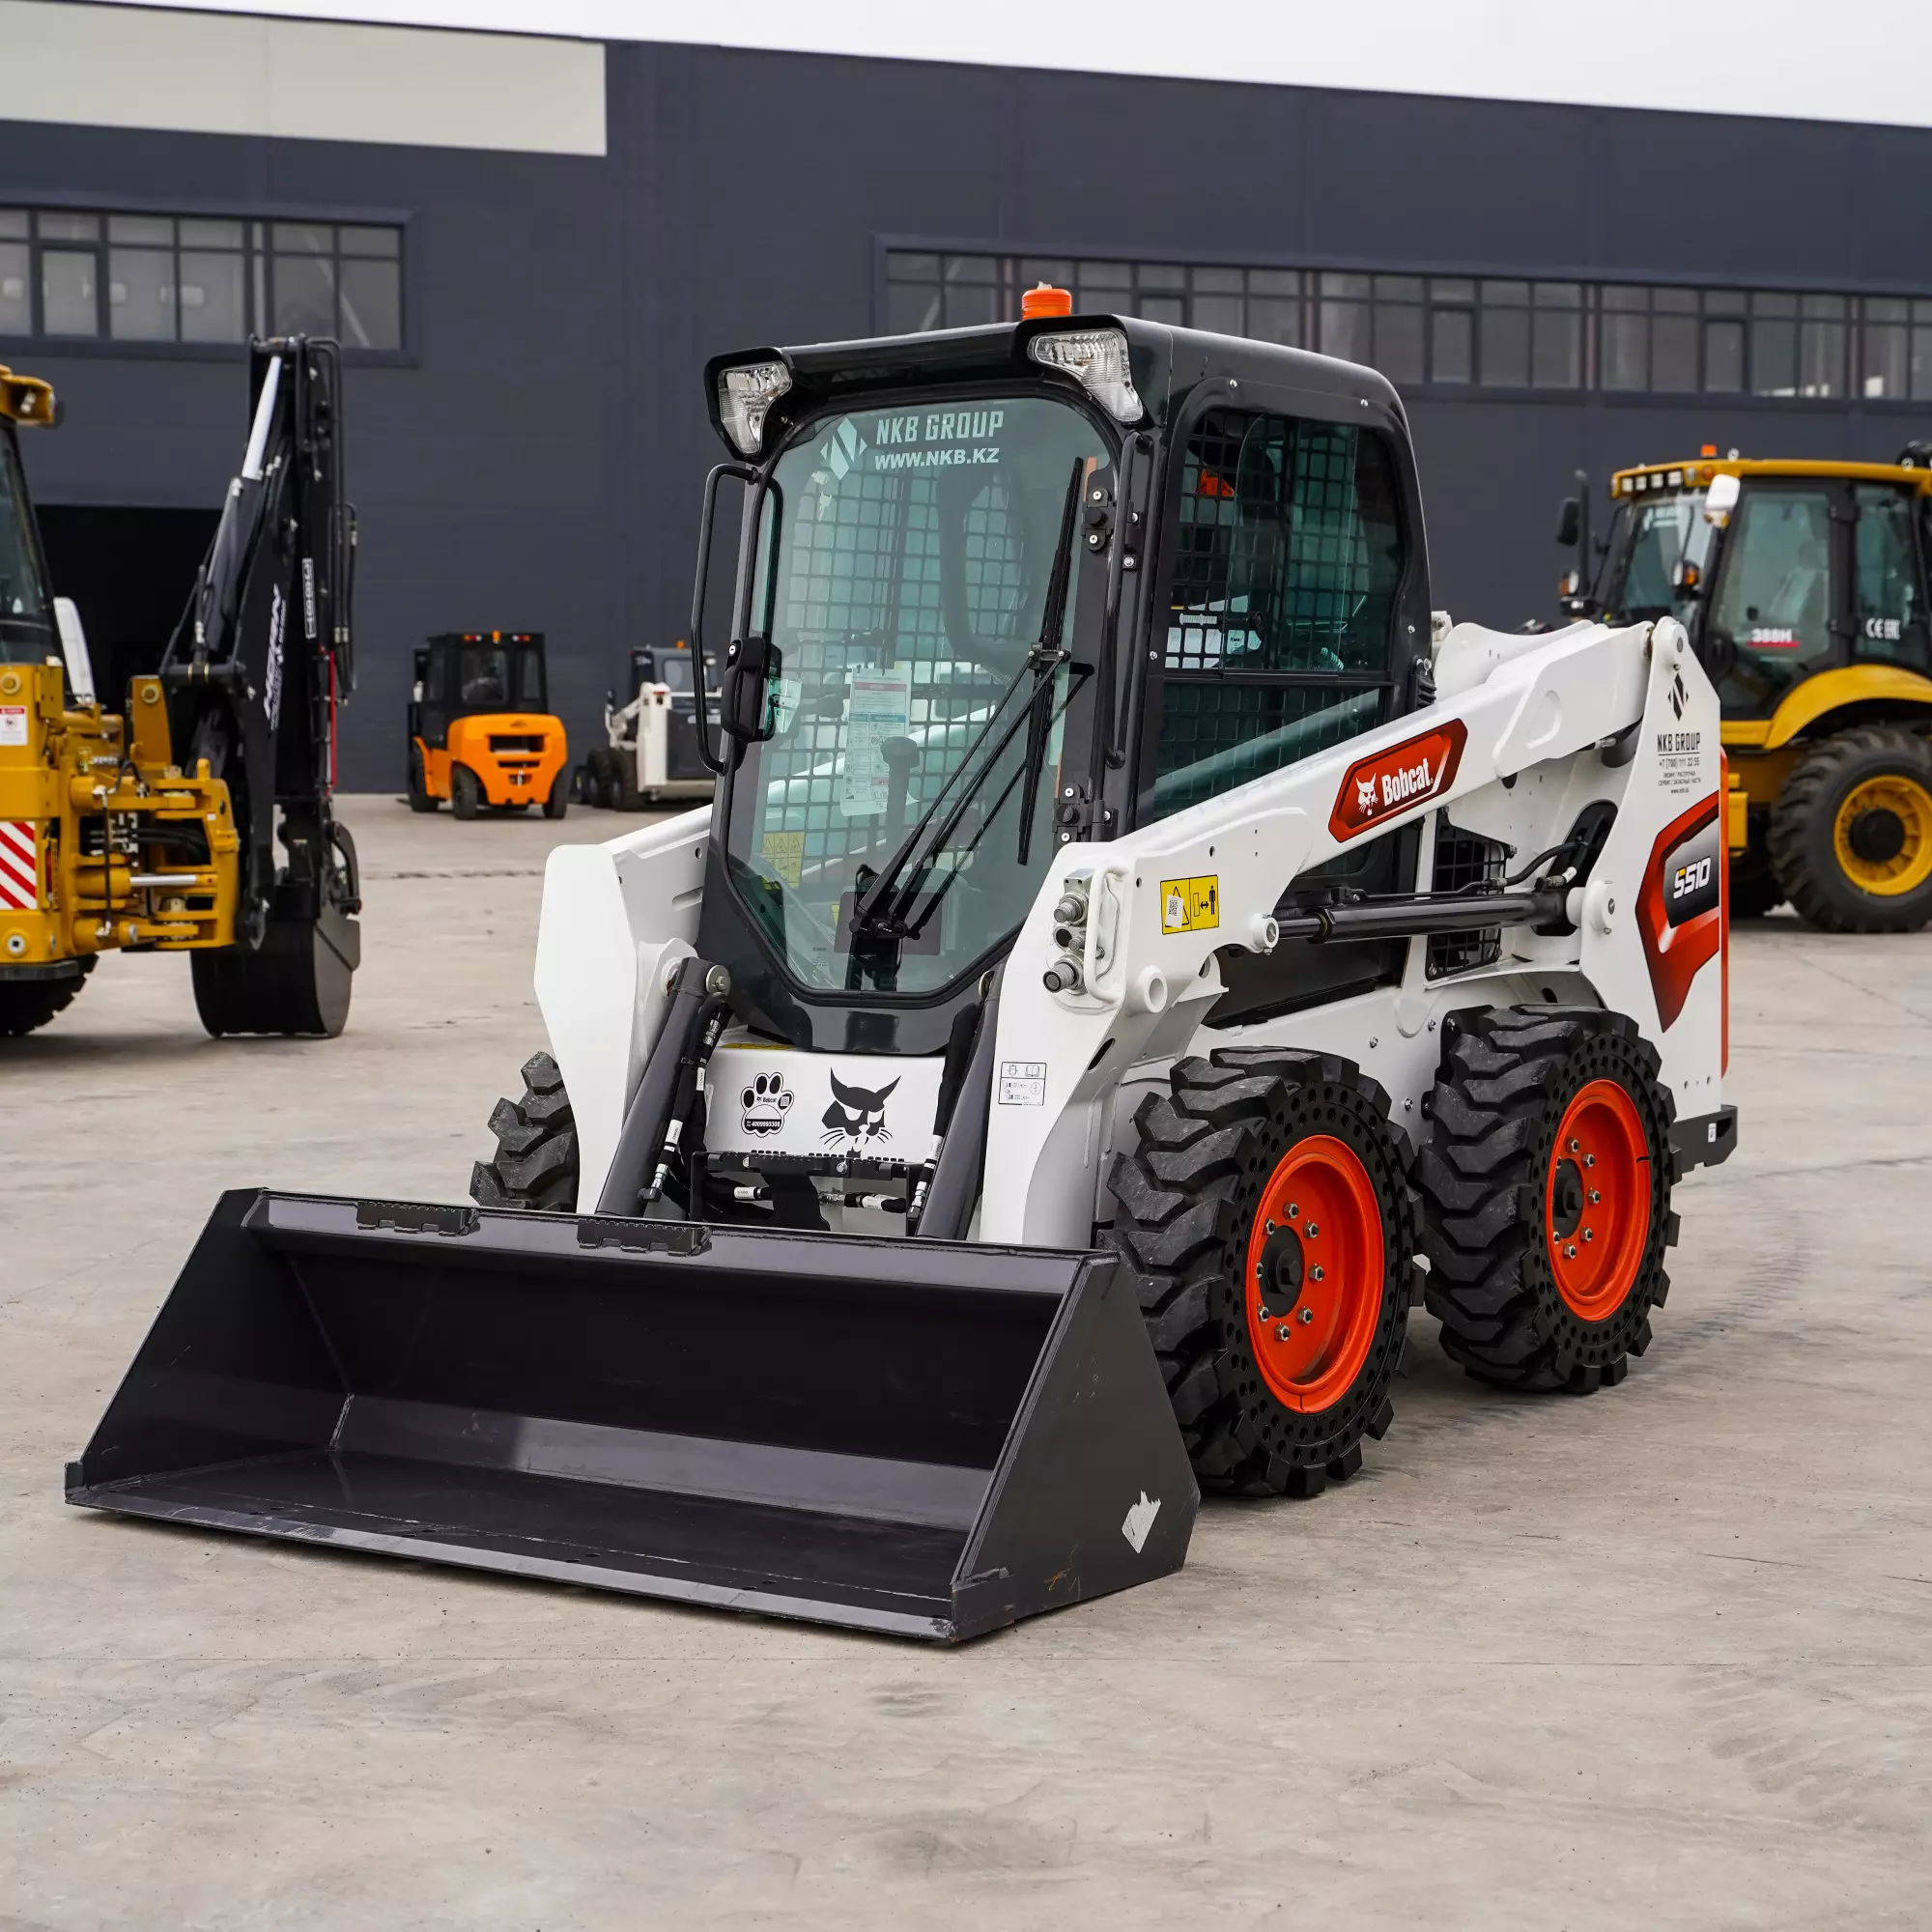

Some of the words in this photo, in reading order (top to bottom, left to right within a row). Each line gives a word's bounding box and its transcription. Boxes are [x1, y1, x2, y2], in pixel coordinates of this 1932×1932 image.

[876, 416, 919, 444] NKB
[924, 411, 1005, 440] GROUP
[875, 447, 1000, 470] WWW.NKB.KZ
[1657, 733, 1673, 753] NKB
[1675, 732, 1701, 752] GROUP
[1381, 757, 1431, 807] Bobcat
[1673, 856, 1712, 899] S510
